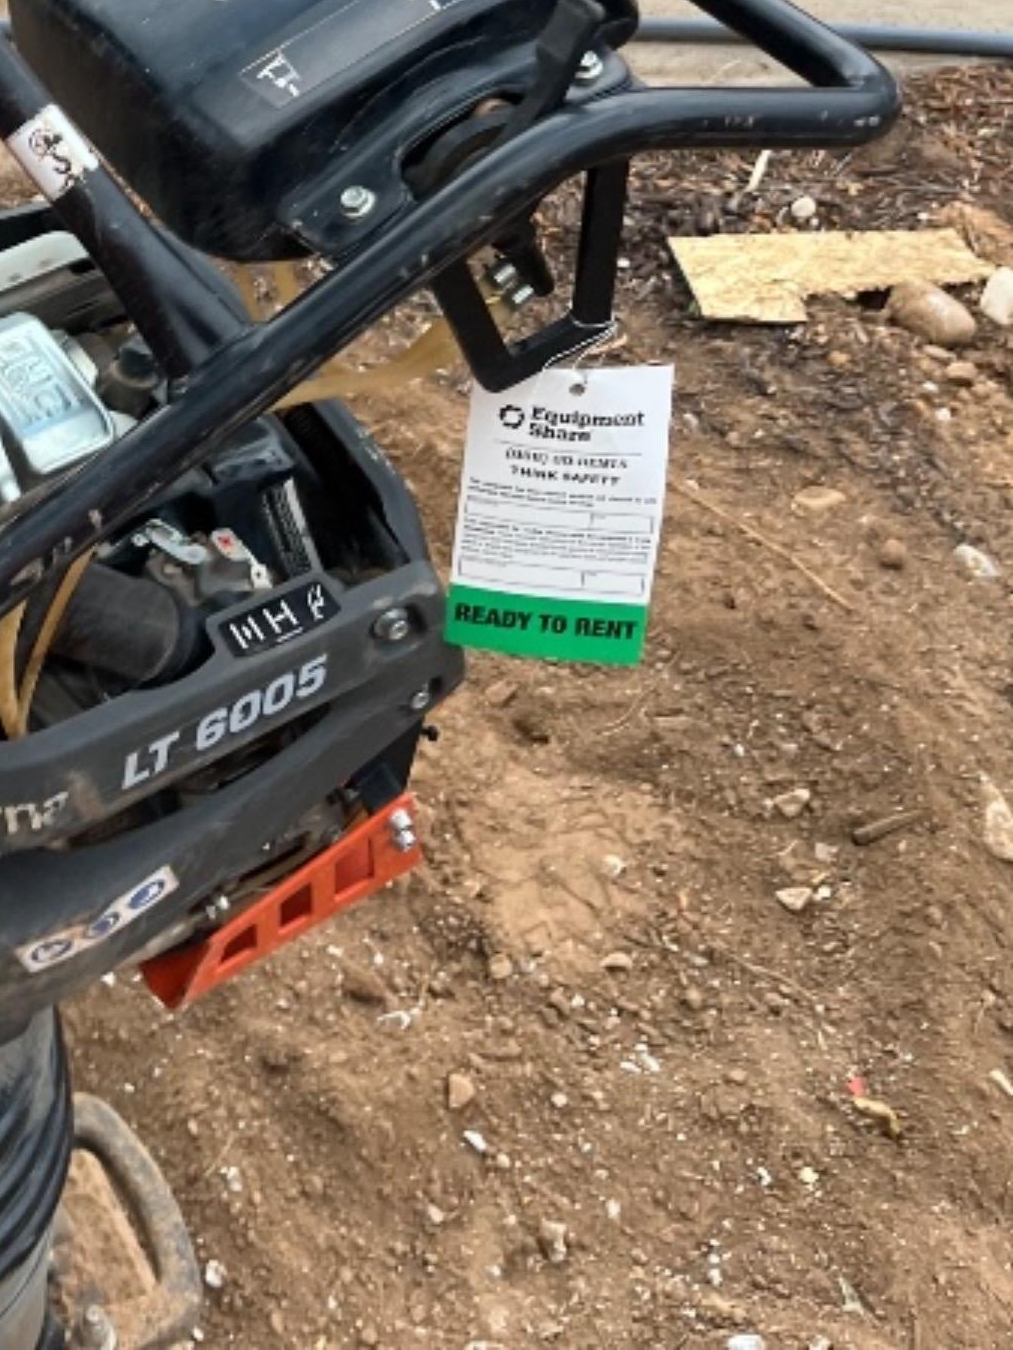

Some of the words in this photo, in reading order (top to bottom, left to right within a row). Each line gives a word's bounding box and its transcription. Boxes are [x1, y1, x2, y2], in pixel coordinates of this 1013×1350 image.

[528, 422, 592, 443] Share
[531, 406, 645, 430] Equipment
[453, 602, 532, 631] READY
[538, 613, 567, 635] TO
[574, 616, 639, 640] RENT
[121, 730, 181, 790] LT
[195, 652, 329, 751] 6005
